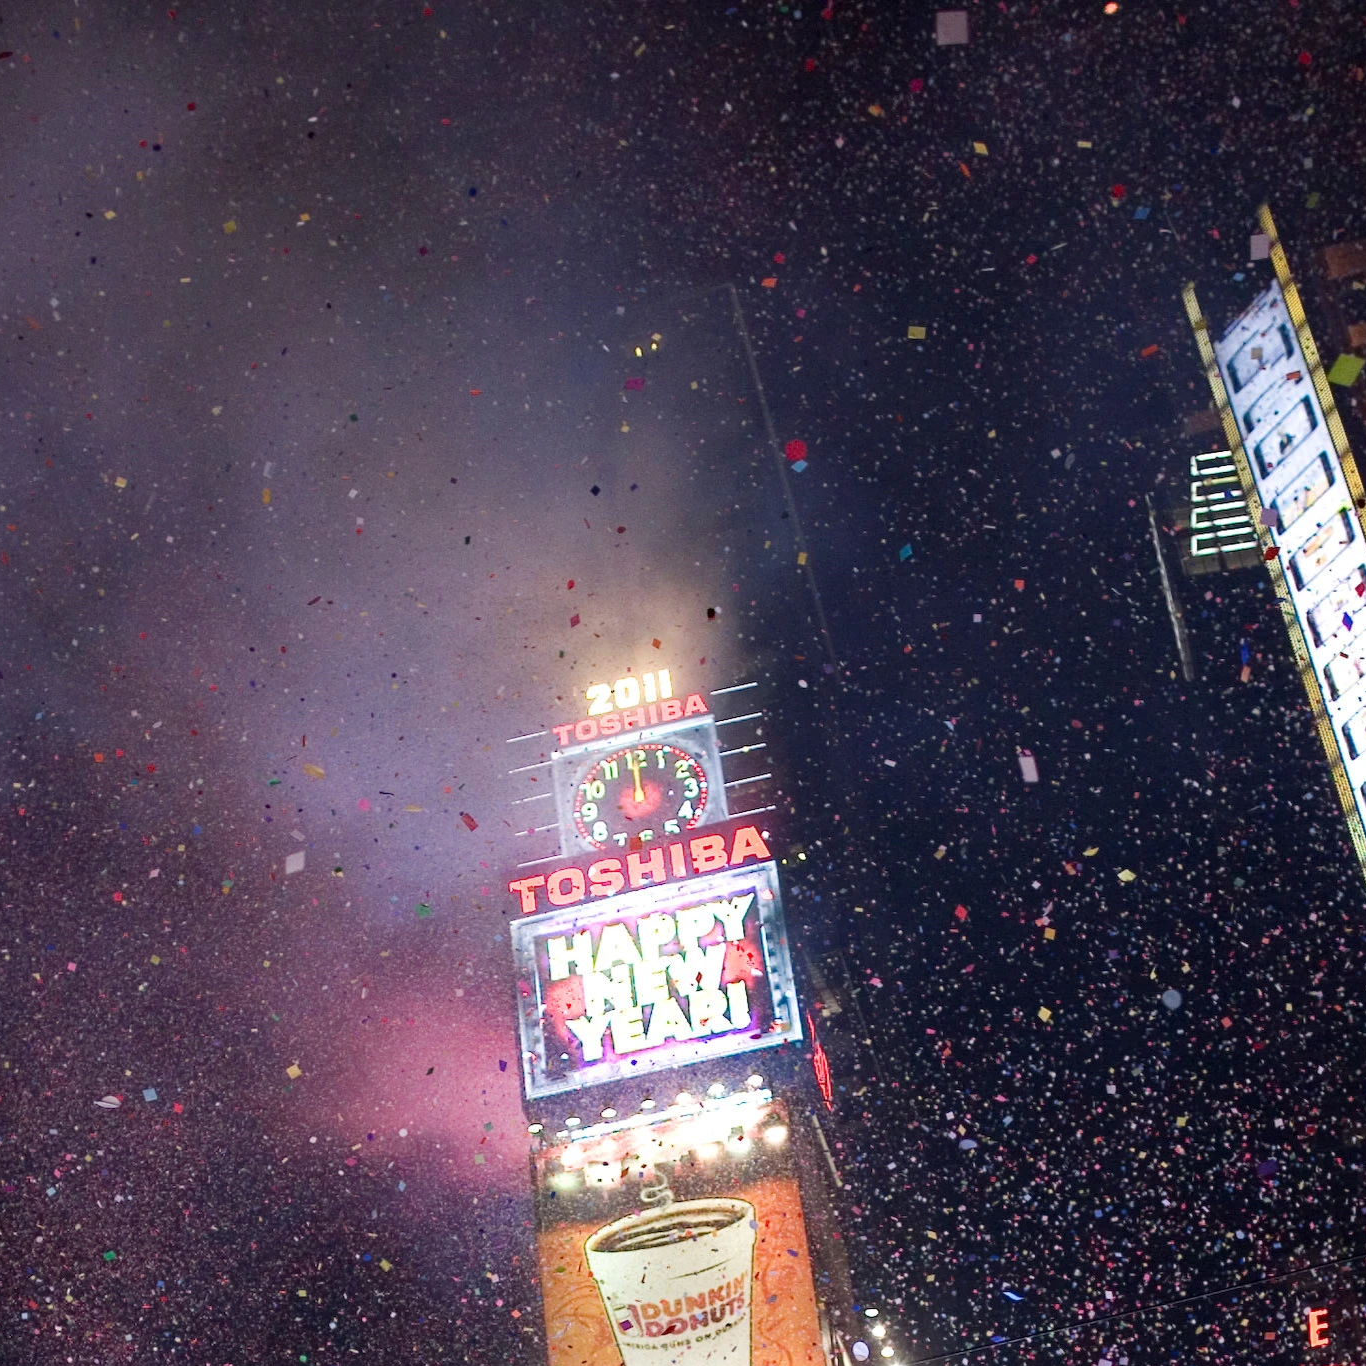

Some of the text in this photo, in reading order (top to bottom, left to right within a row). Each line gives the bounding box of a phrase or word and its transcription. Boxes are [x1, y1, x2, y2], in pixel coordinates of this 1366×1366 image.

[586, 668, 674, 717] 2011
[552, 693, 709, 747] TOSHIBA
[584, 778, 605, 798] 10
[673, 759, 690, 779] 2
[682, 777, 699, 797] 3
[678, 800, 693, 819] 4
[509, 825, 772, 915] TOSHIBA
[547, 893, 756, 982] HAPPY
[581, 941, 727, 1012] NEW
[565, 980, 752, 1062] YEAR!
[644, 1291, 746, 1338] DONUTS
